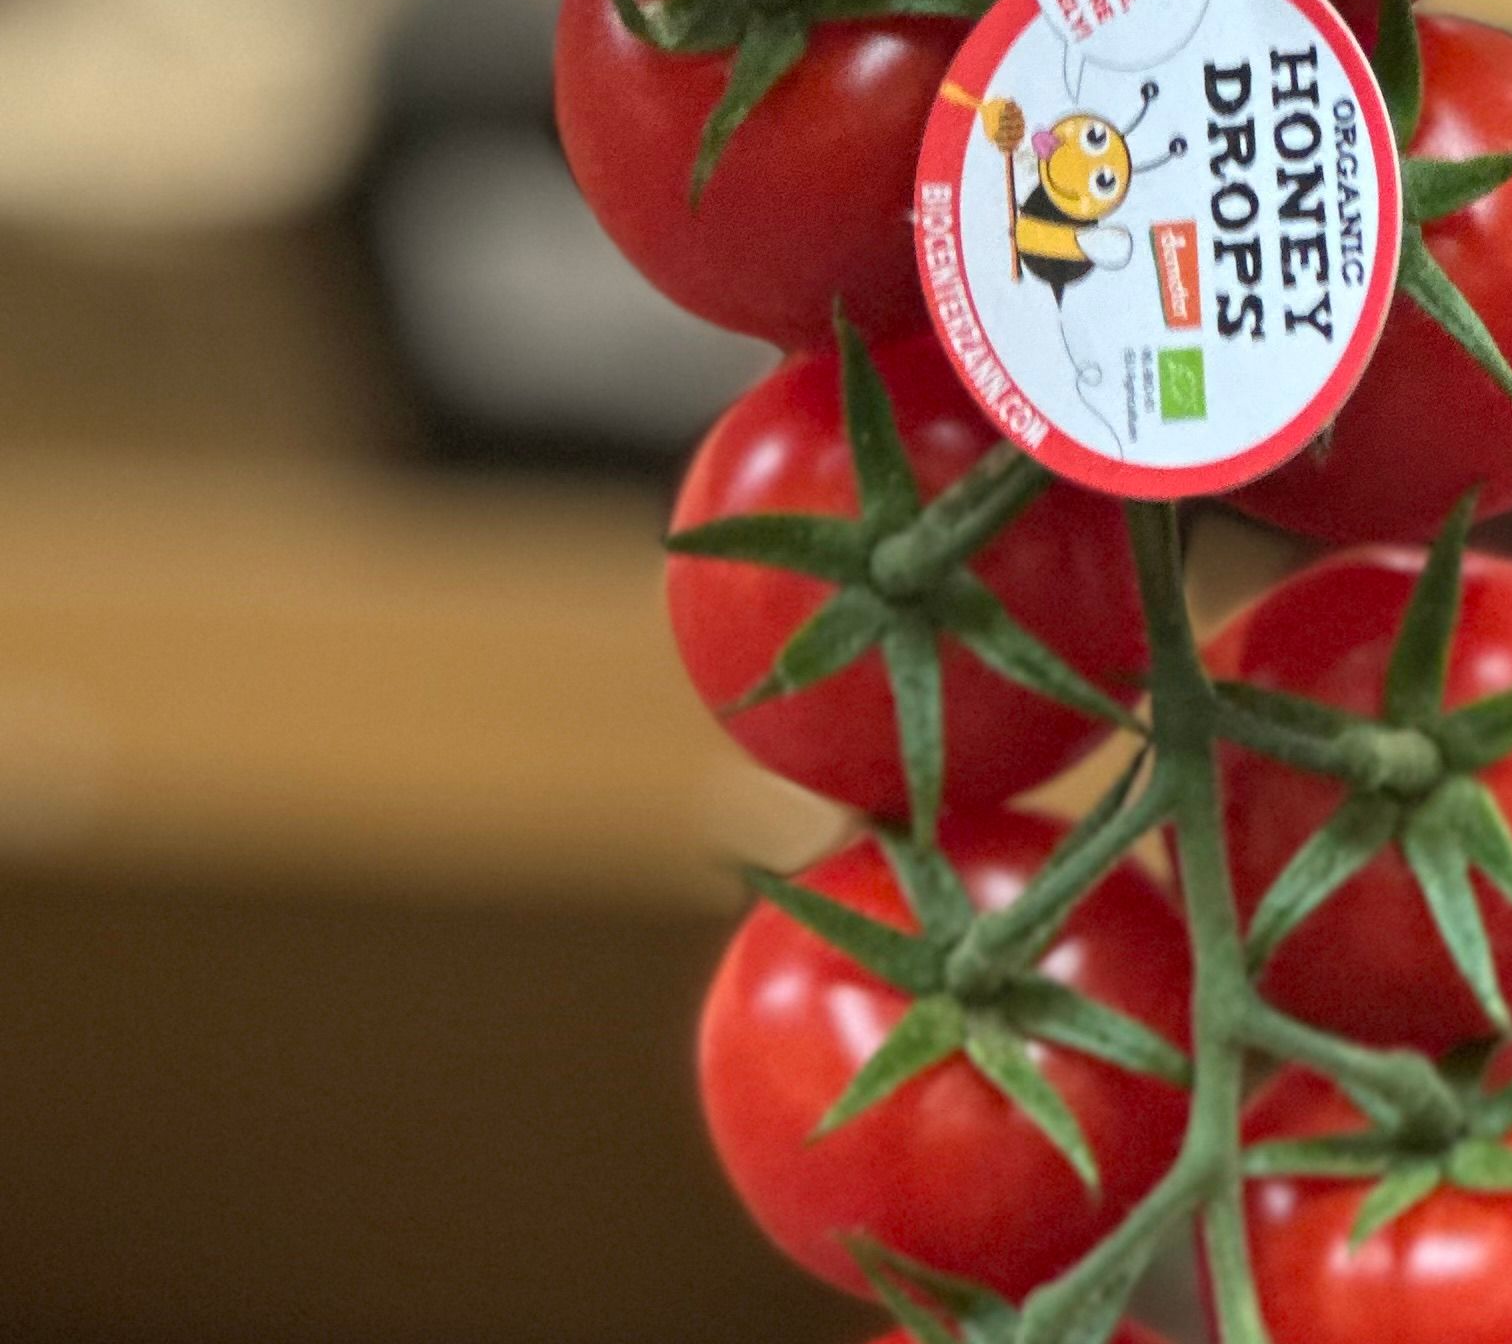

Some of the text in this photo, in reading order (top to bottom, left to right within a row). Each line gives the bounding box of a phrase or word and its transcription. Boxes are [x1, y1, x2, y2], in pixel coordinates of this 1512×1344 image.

[1204, 60, 1265, 342] DROPS
[1270, 44, 1333, 342] HONEY
[1333, 98, 1364, 286] ORGANIC
